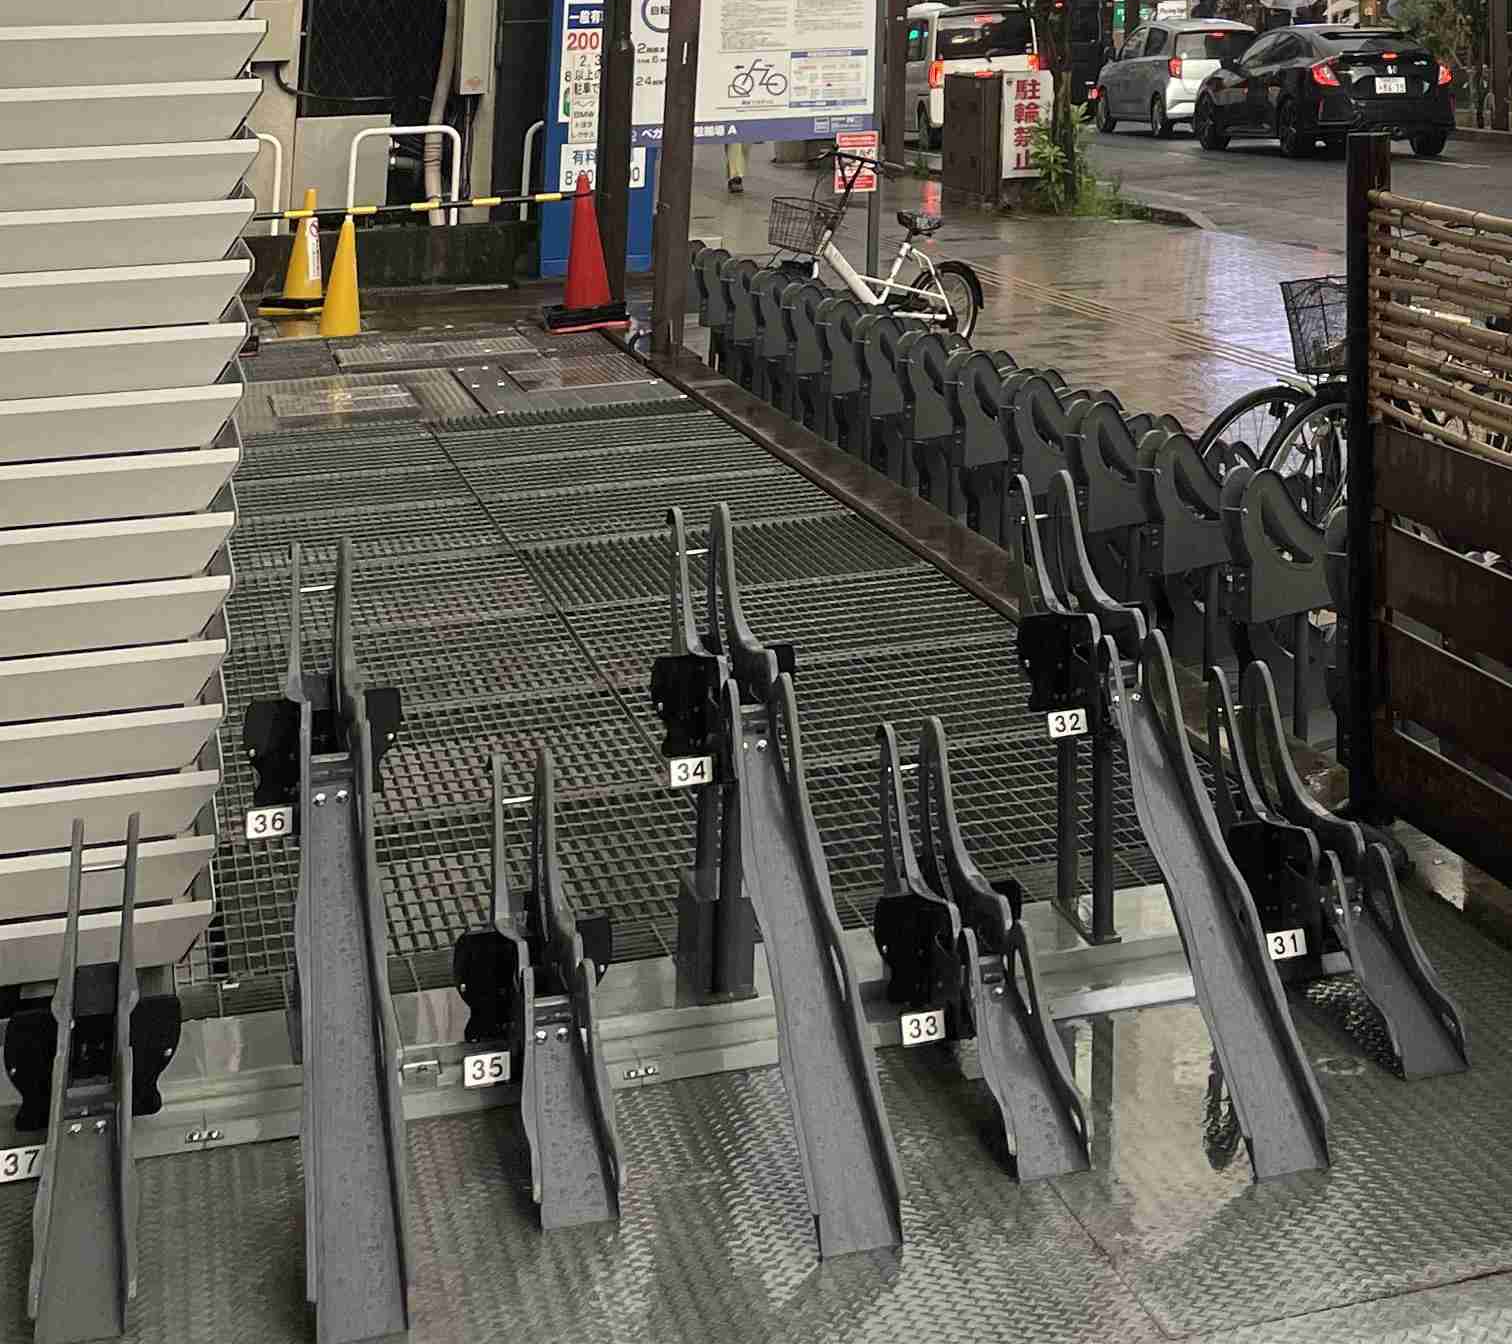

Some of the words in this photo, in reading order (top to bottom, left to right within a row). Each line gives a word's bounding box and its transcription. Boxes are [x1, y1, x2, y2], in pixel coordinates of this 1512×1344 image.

[567, 31, 599, 50] 200
[1056, 714, 1081, 733] 32
[677, 761, 705, 782] 34
[254, 812, 285, 834] 36
[1273, 933, 1298, 955] 31
[910, 1015, 938, 1039] 33
[472, 1056, 503, 1081] 35
[4, 1149, 40, 1177] 37
